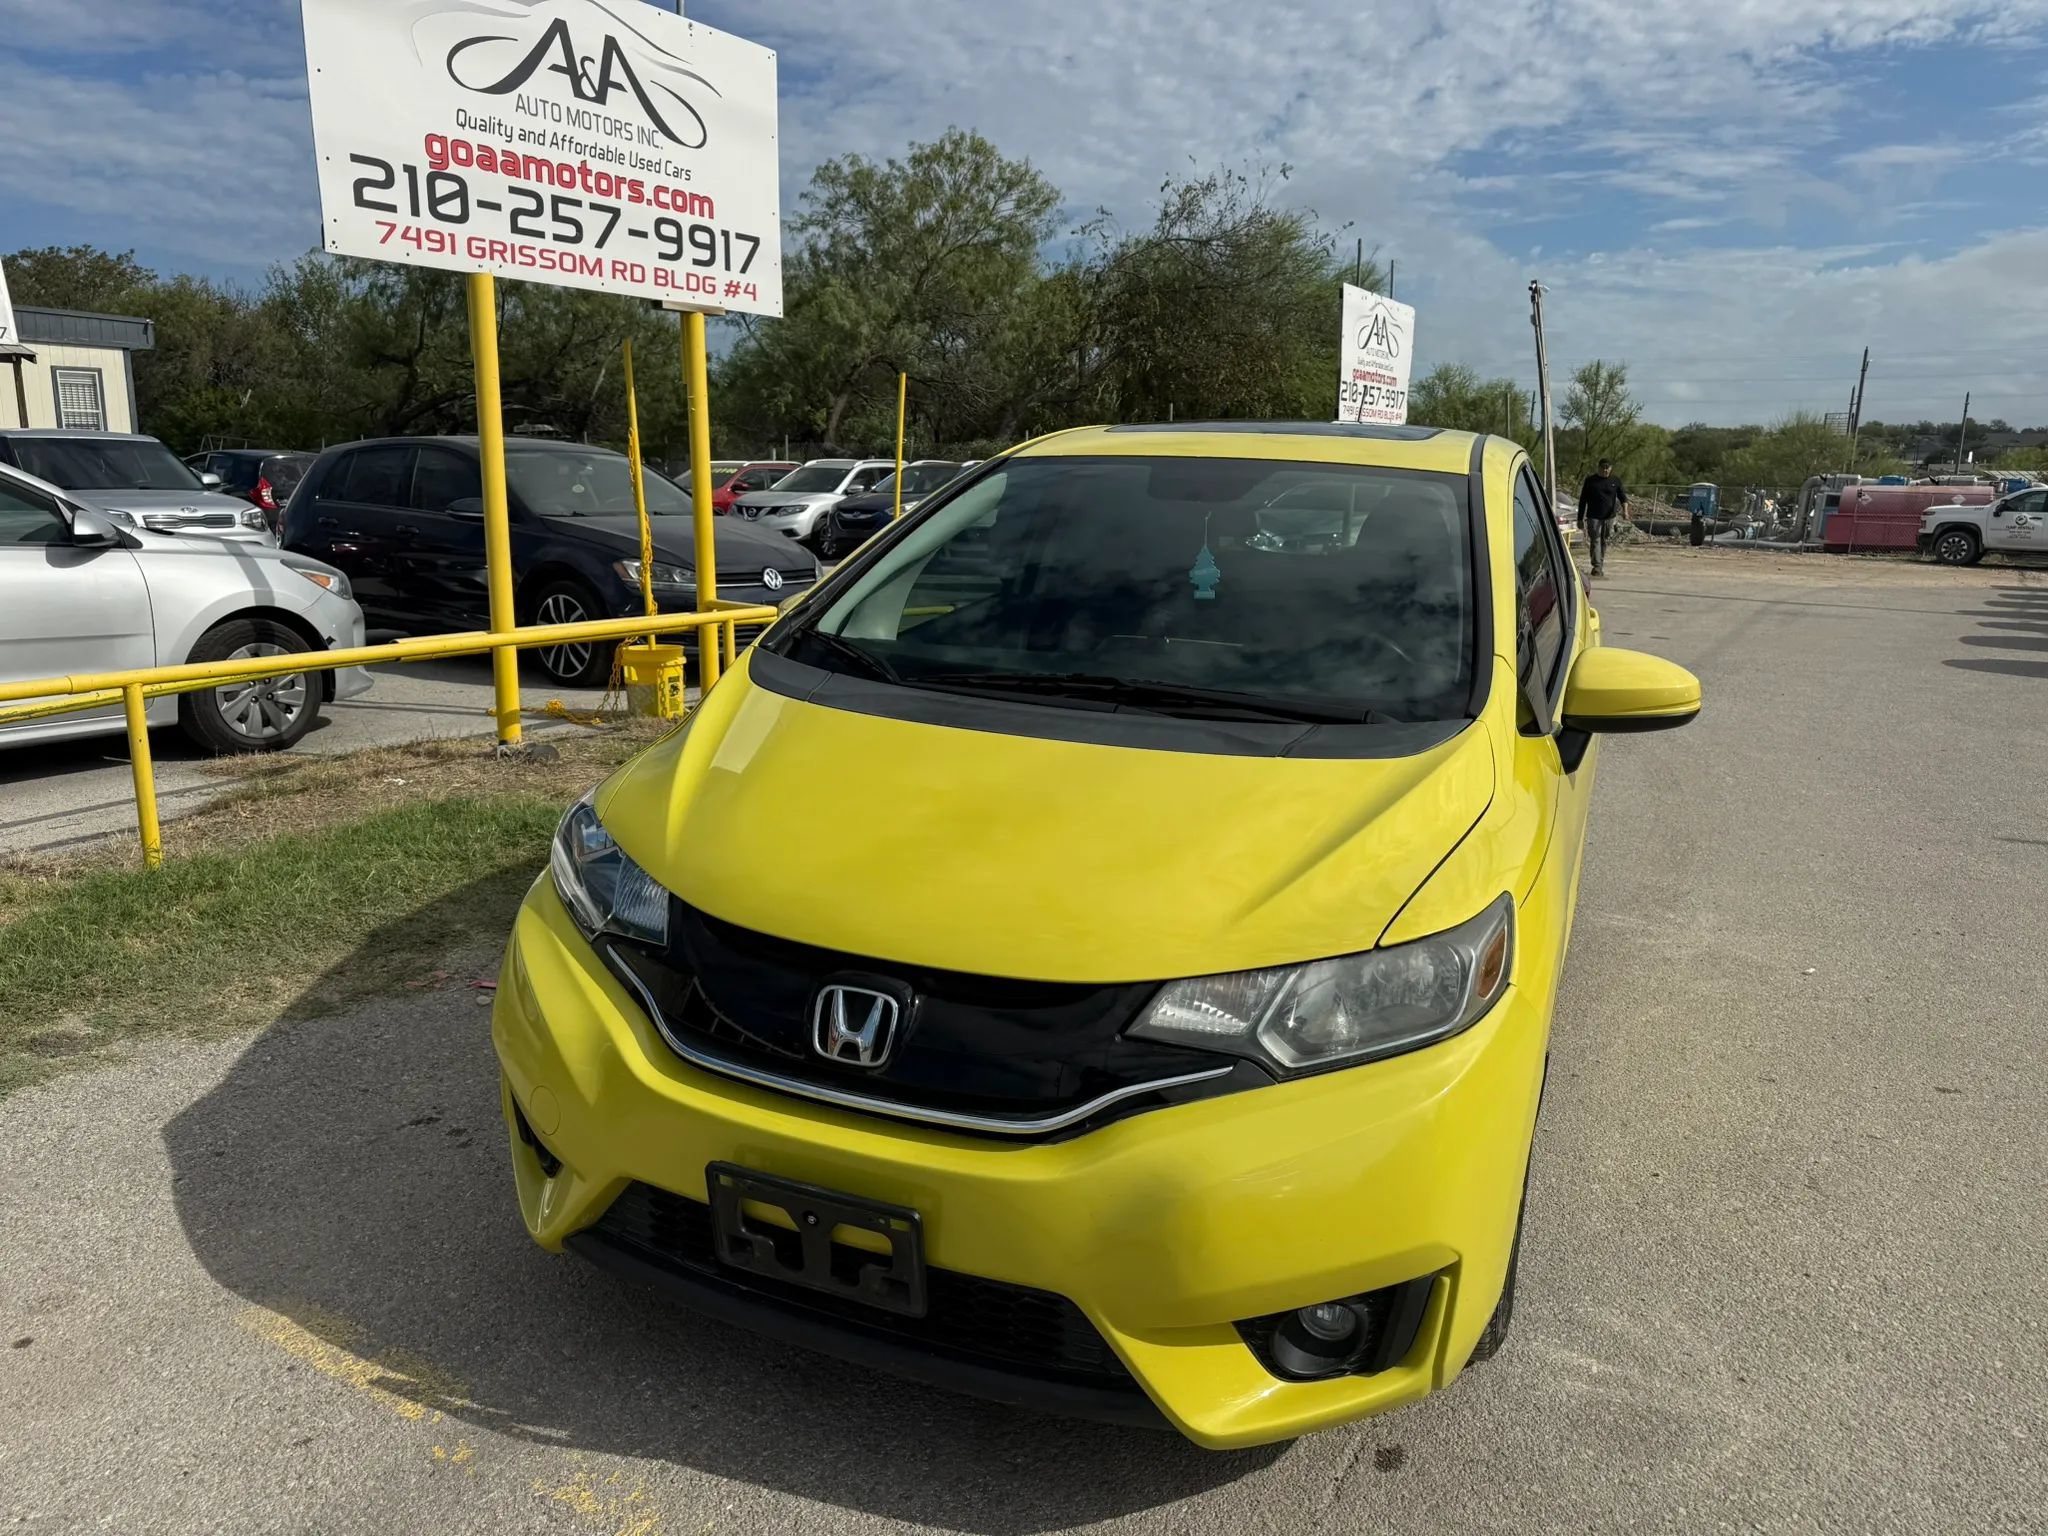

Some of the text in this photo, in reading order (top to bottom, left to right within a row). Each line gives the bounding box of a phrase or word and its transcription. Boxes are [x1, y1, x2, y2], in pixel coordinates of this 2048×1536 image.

[447, 17, 707, 149] A&A
[515, 93, 664, 150] AUTO MOTORS INC.
[424, 132, 715, 220] goaamotors.com
[455, 108, 692, 181] Quality and Affordable Used Cars
[349, 152, 761, 274] 210-257-9917
[374, 220, 758, 302] 7491 GRISSOM RD BLDG #4
